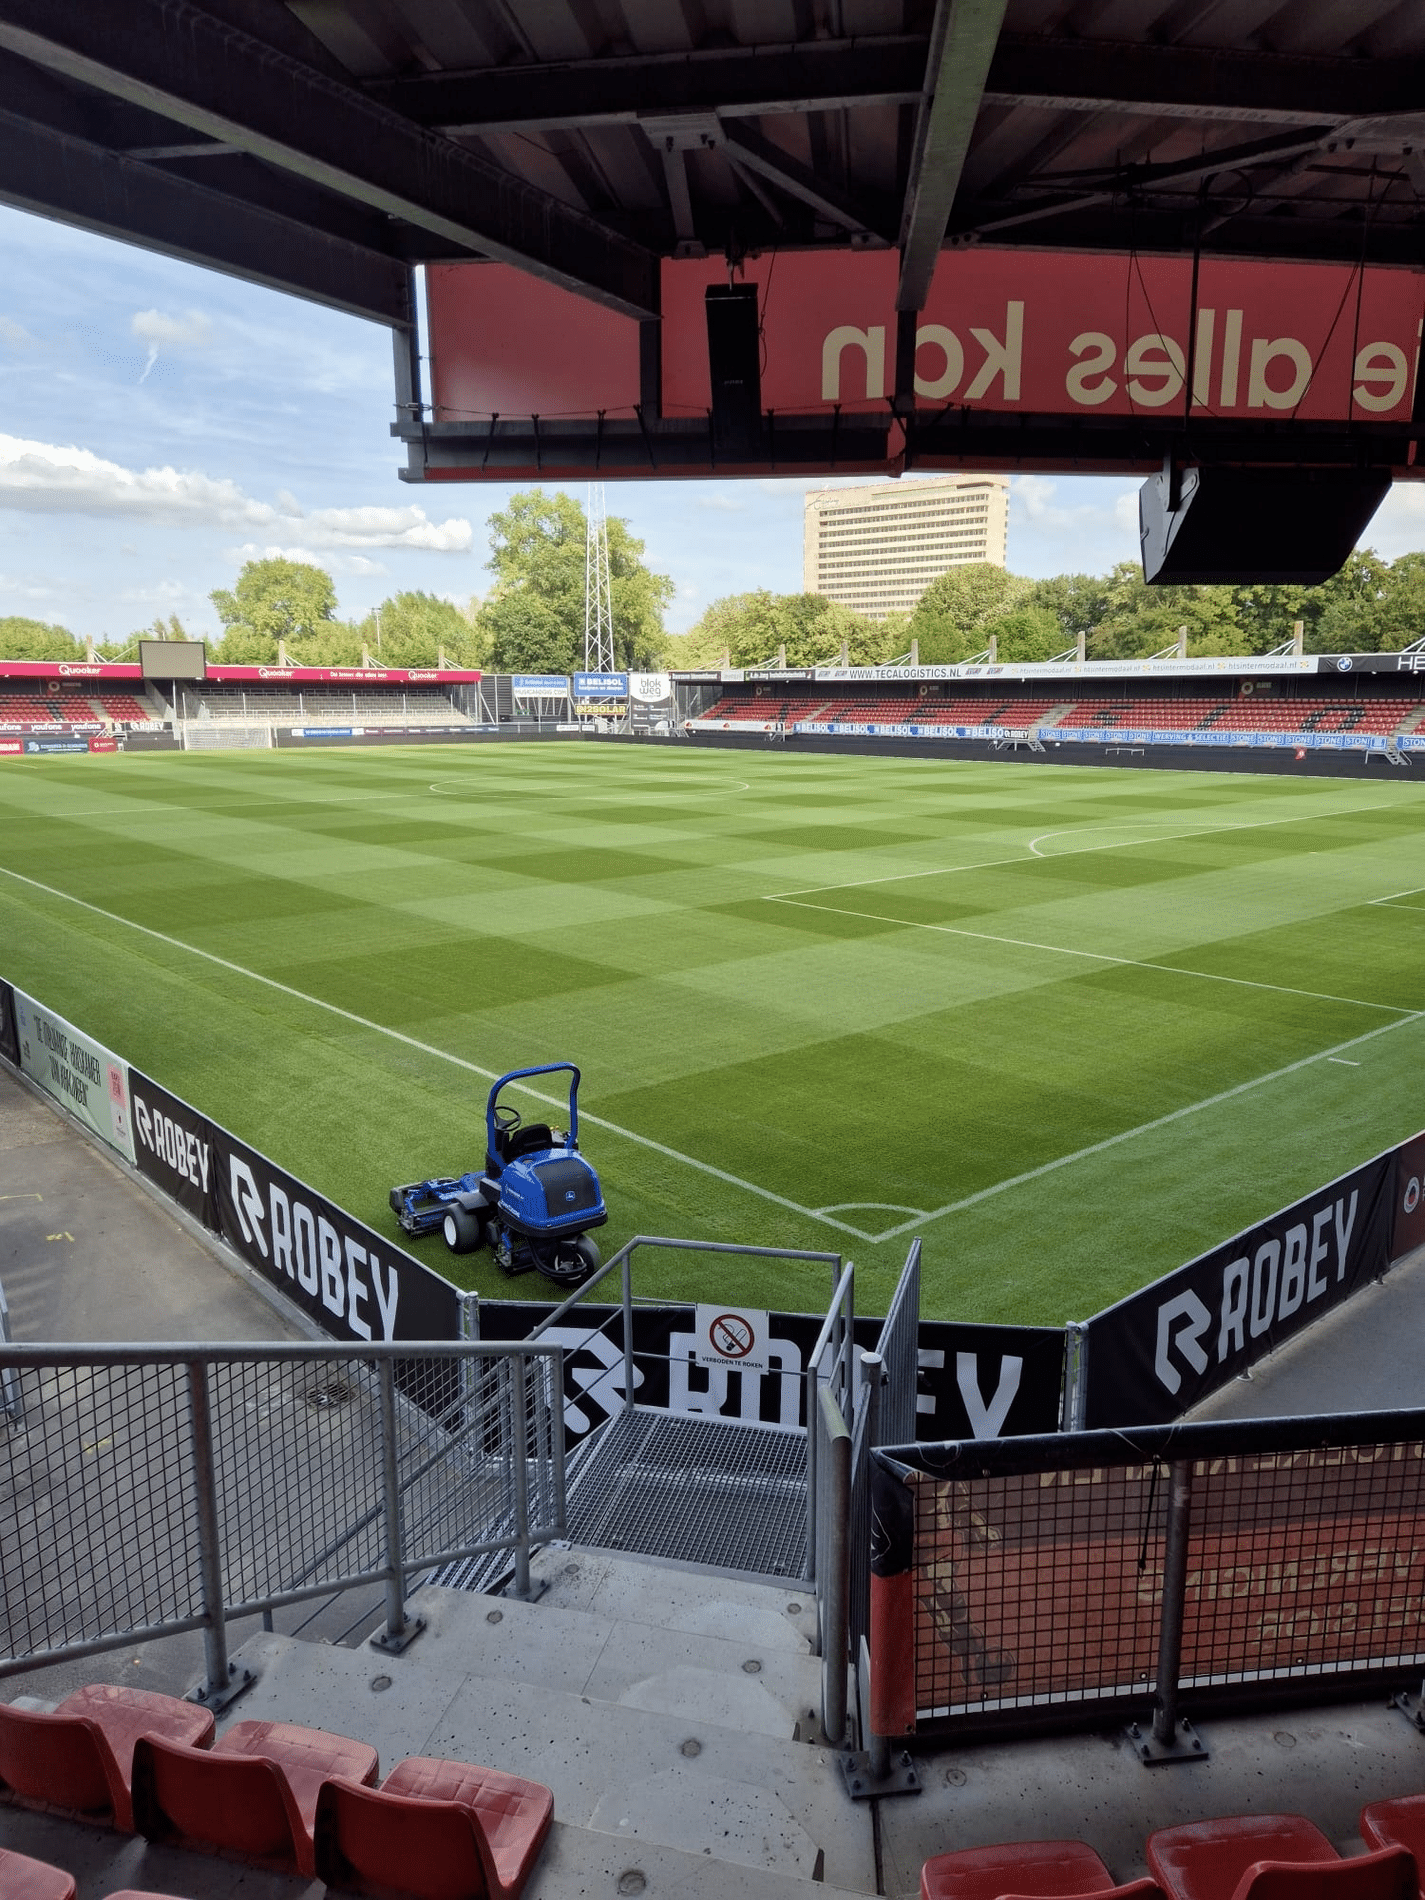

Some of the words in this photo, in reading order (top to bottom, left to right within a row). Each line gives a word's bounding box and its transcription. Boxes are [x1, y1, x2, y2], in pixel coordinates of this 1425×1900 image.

[849, 668, 962, 679] WWW.TECALOGISTICS.NL
[640, 678, 661, 688] blok
[639, 687, 661, 697] weg
[576, 705, 626, 713] IN2SOLAR
[153, 1108, 209, 1194] ROBEY
[269, 1182, 399, 1341] ROBEY
[1218, 1189, 1359, 1364] ROBEY
[701, 1356, 734, 1366] VERBODEN
[742, 1361, 763, 1369] ROKEN
